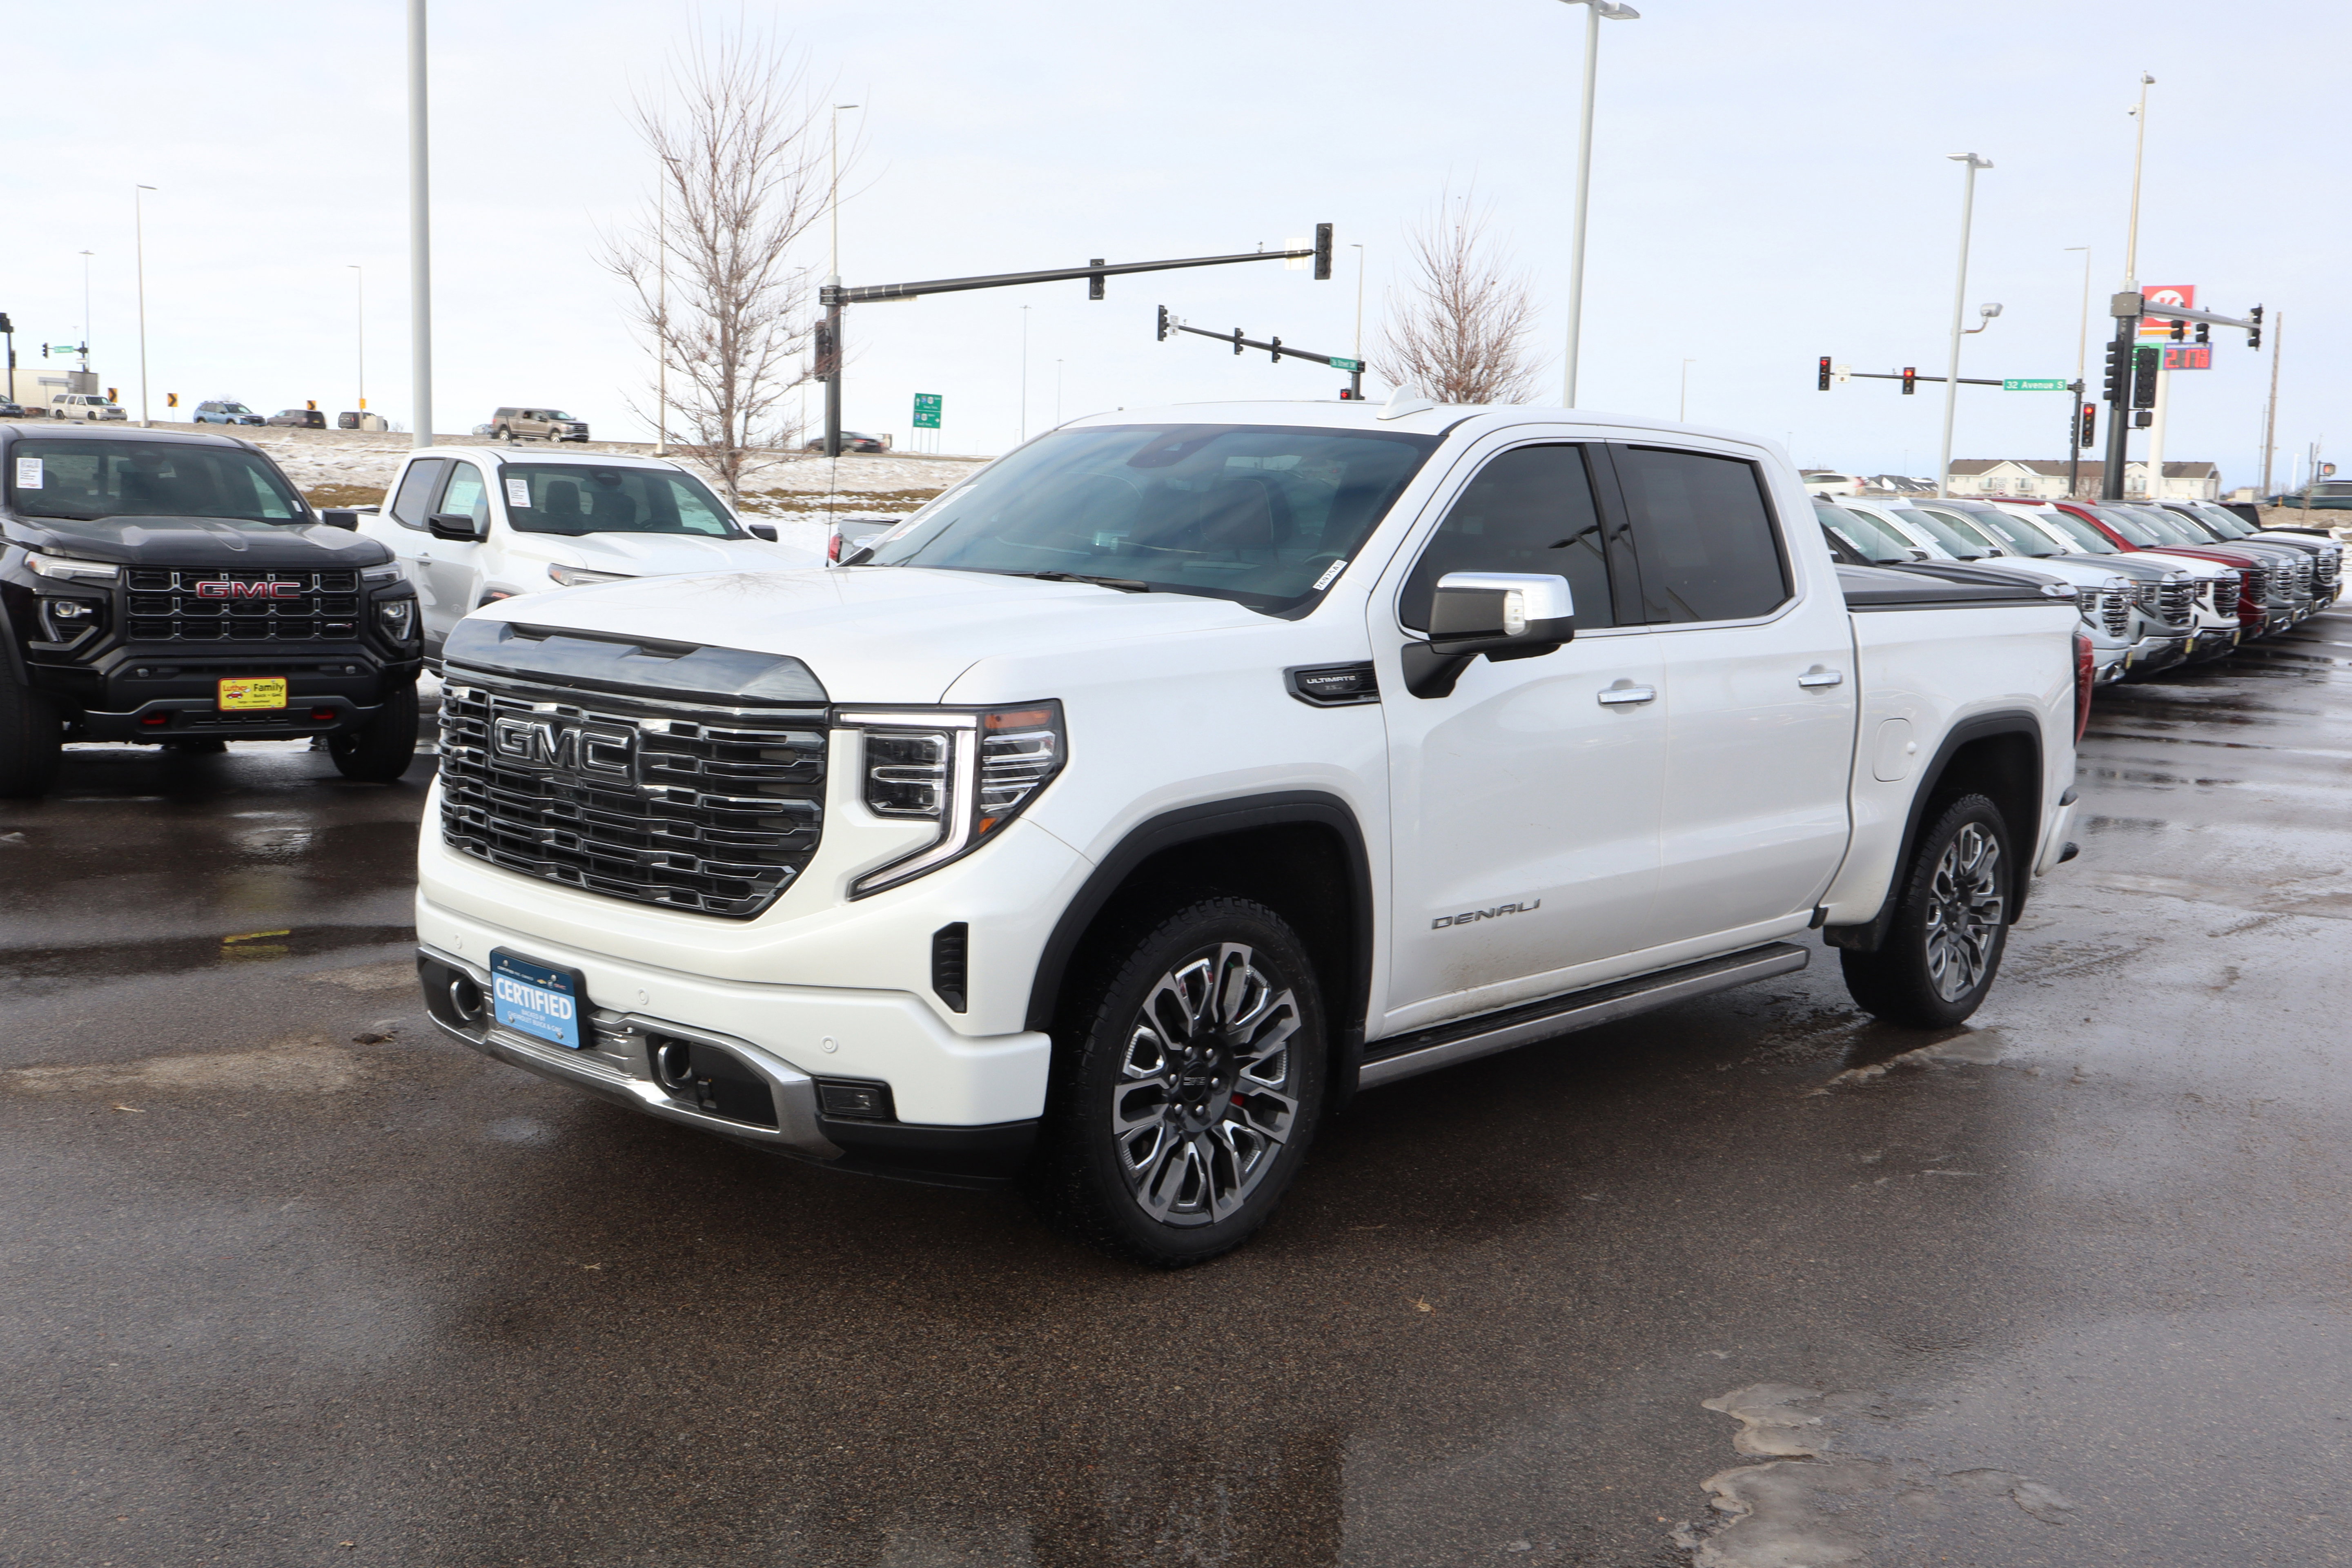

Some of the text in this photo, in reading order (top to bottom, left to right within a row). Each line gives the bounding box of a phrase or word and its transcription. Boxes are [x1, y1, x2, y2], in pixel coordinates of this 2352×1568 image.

[196, 581, 301, 599] GMC
[1306, 676, 1356, 684] ULTIMATE
[254, 683, 285, 692] Family
[494, 717, 630, 778] GMC
[1431, 898, 1541, 929] DENALI
[495, 978, 572, 1020] CERTIFIED
[521, 1009, 539, 1020] BACKED
[532, 1019, 547, 1029] BUICK
